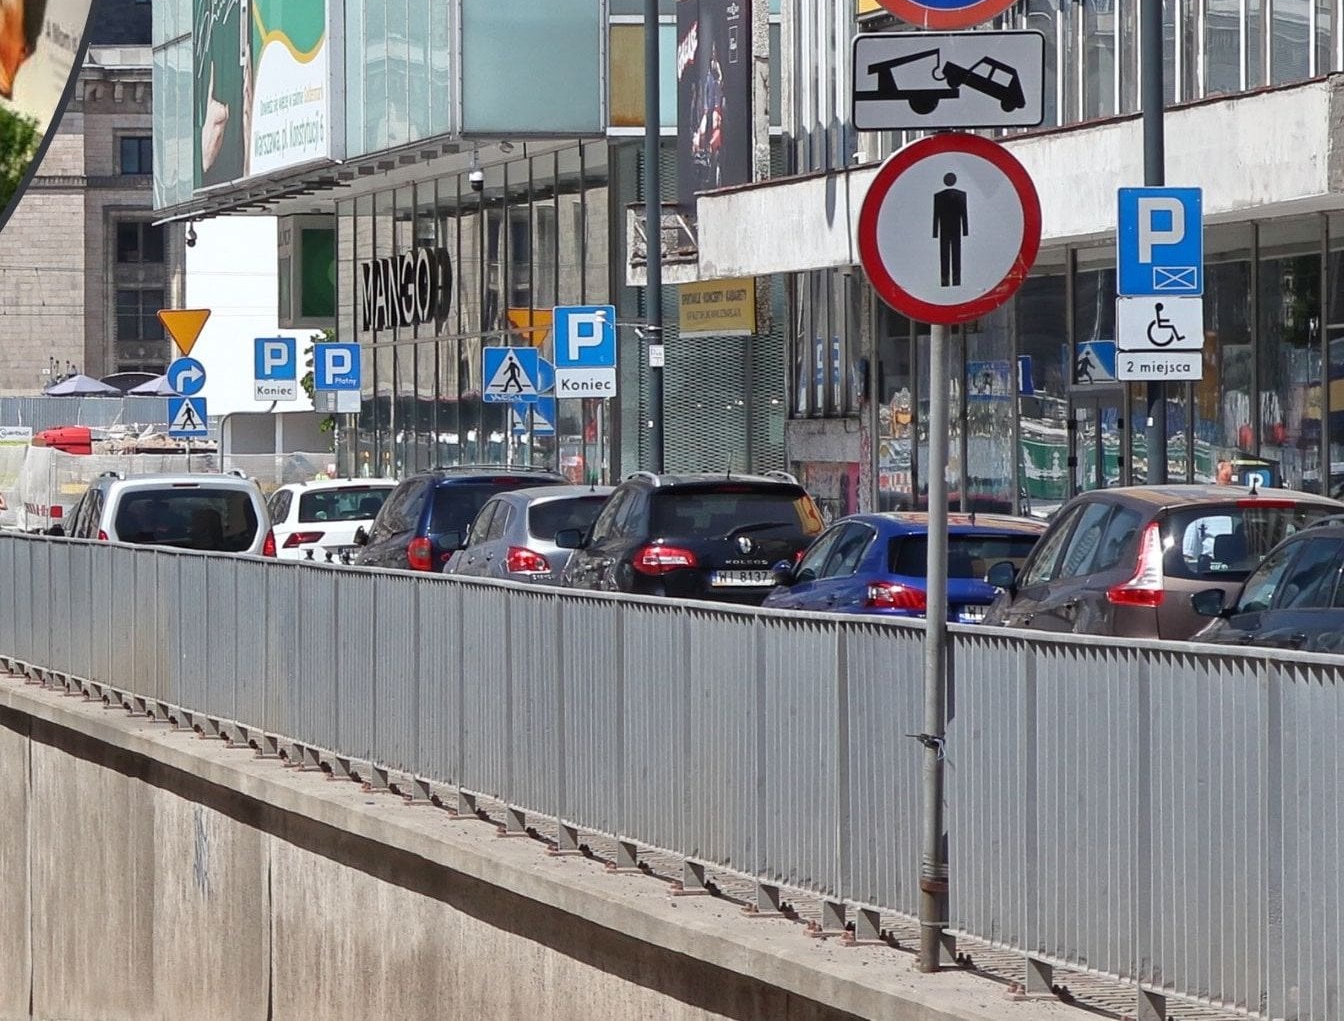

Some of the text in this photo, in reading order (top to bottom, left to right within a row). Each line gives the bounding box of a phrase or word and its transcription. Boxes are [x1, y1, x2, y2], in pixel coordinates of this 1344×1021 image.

[1138, 197, 1185, 264] P
[361, 247, 432, 331] MANGO
[568, 313, 604, 360] P
[264, 342, 288, 375] P
[325, 349, 351, 385] P
[1126, 361, 1191, 376] 2 miejsca
[257, 386, 293, 395] Koniec
[562, 378, 611, 391] Koniec
[719, 571, 733, 583] WI
